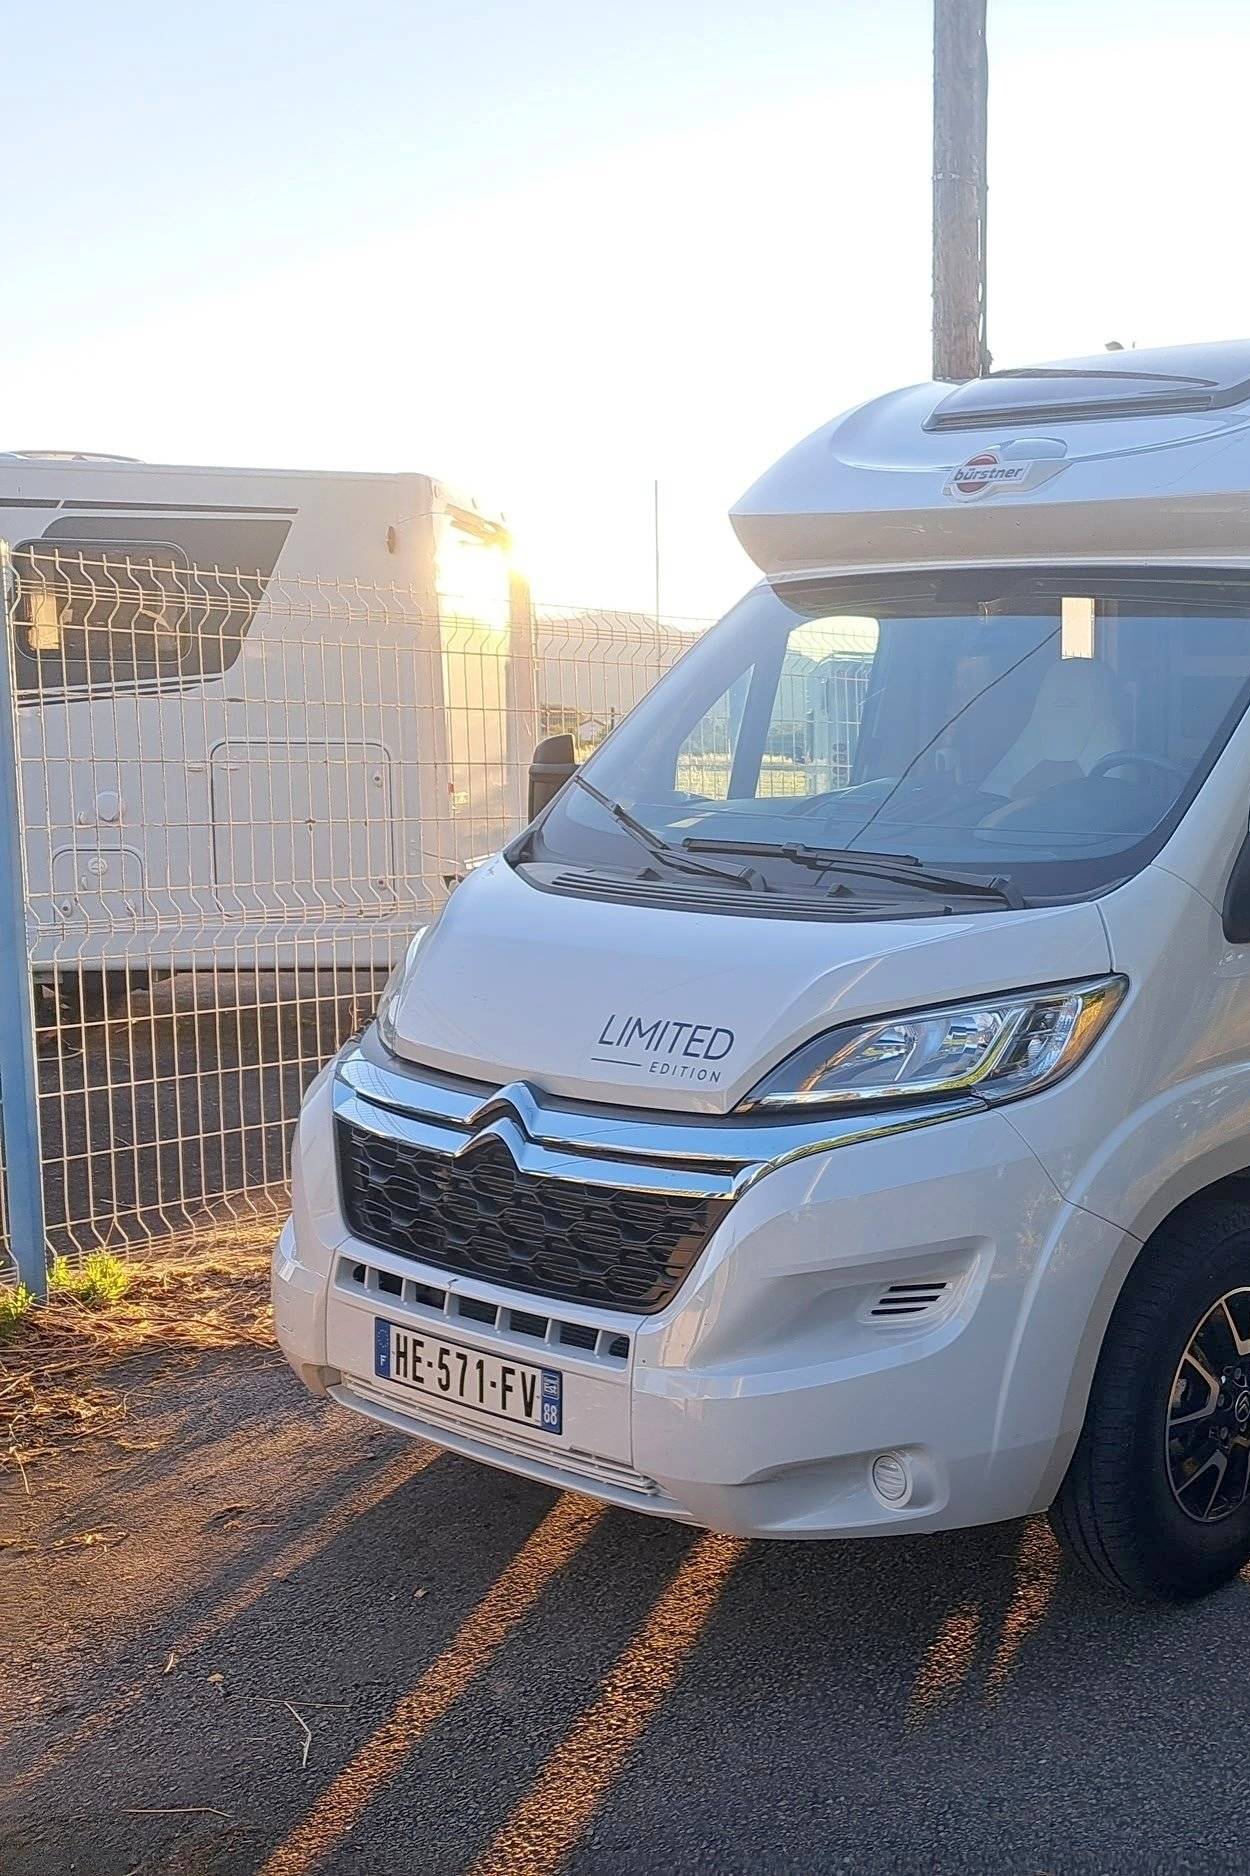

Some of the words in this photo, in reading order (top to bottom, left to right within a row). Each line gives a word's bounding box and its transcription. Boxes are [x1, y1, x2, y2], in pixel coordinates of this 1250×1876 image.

[953, 467, 1023, 482] bürstner
[598, 1013, 735, 1061] LIMITED
[649, 1061, 722, 1083] EDITION
[380, 1354, 387, 1366] F
[395, 1332, 537, 1419] HE-571-FV
[543, 1403, 558, 1426] 88
